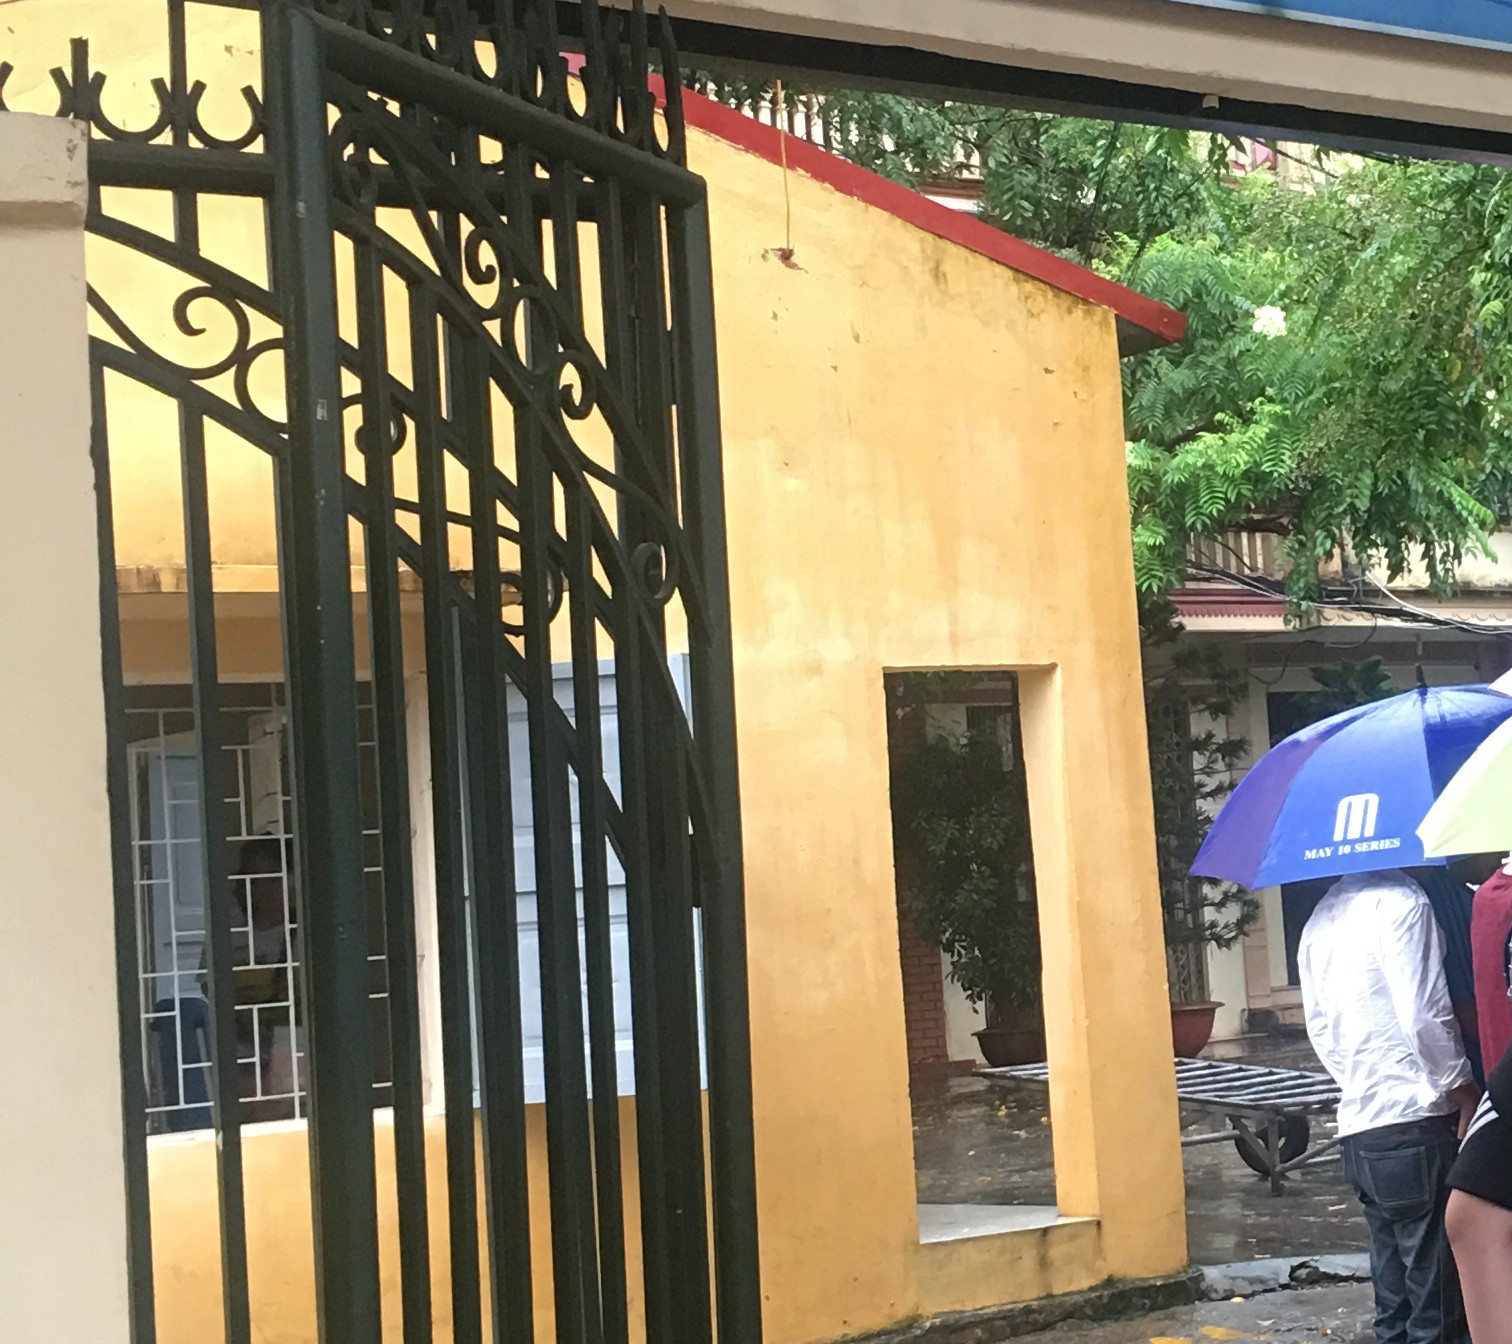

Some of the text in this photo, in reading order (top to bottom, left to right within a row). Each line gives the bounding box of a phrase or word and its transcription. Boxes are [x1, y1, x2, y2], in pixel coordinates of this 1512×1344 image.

[1304, 838, 1400, 860] MAY 10 SERIES
